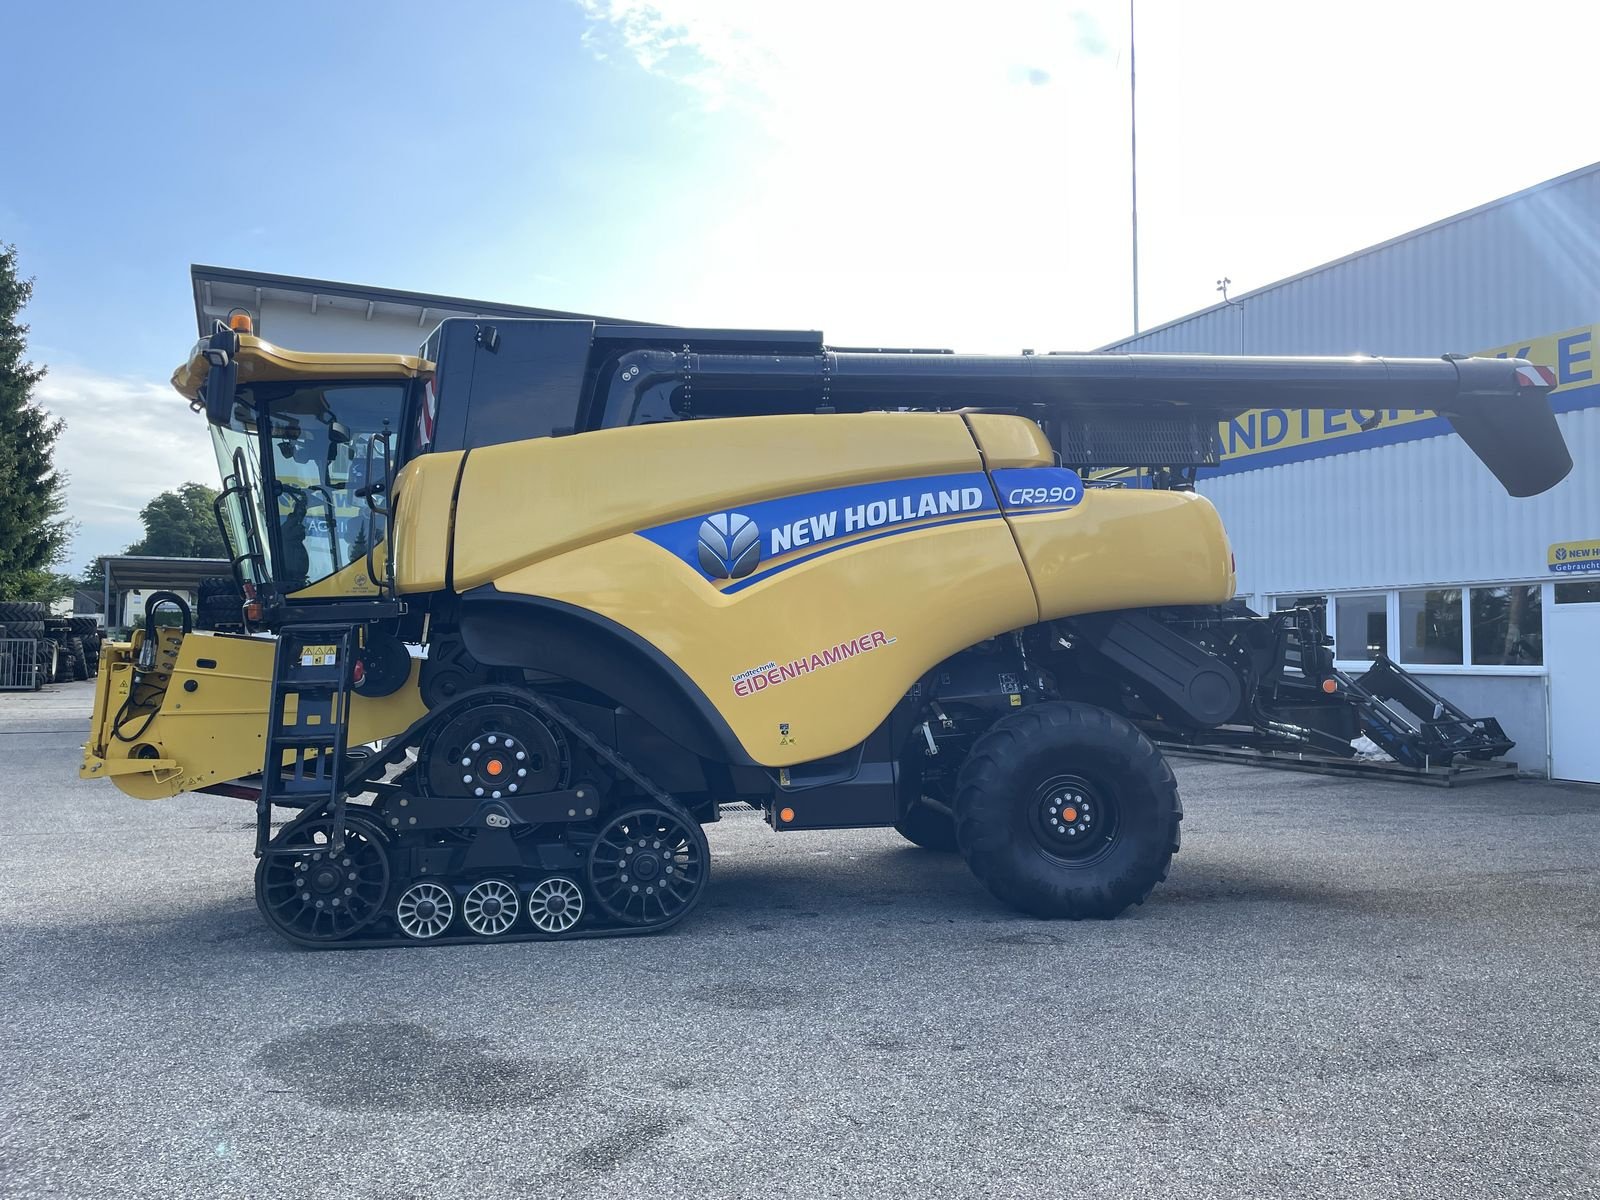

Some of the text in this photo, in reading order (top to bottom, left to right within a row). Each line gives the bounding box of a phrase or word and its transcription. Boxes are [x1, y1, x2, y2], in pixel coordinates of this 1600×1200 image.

[1008, 486, 1077, 506] CR9.90
[771, 487, 983, 555] NEW HOLLAND
[1569, 549, 1590, 558] NEW
[731, 661, 776, 682] Landtechnik
[734, 631, 887, 697] EIDENHAMMER
